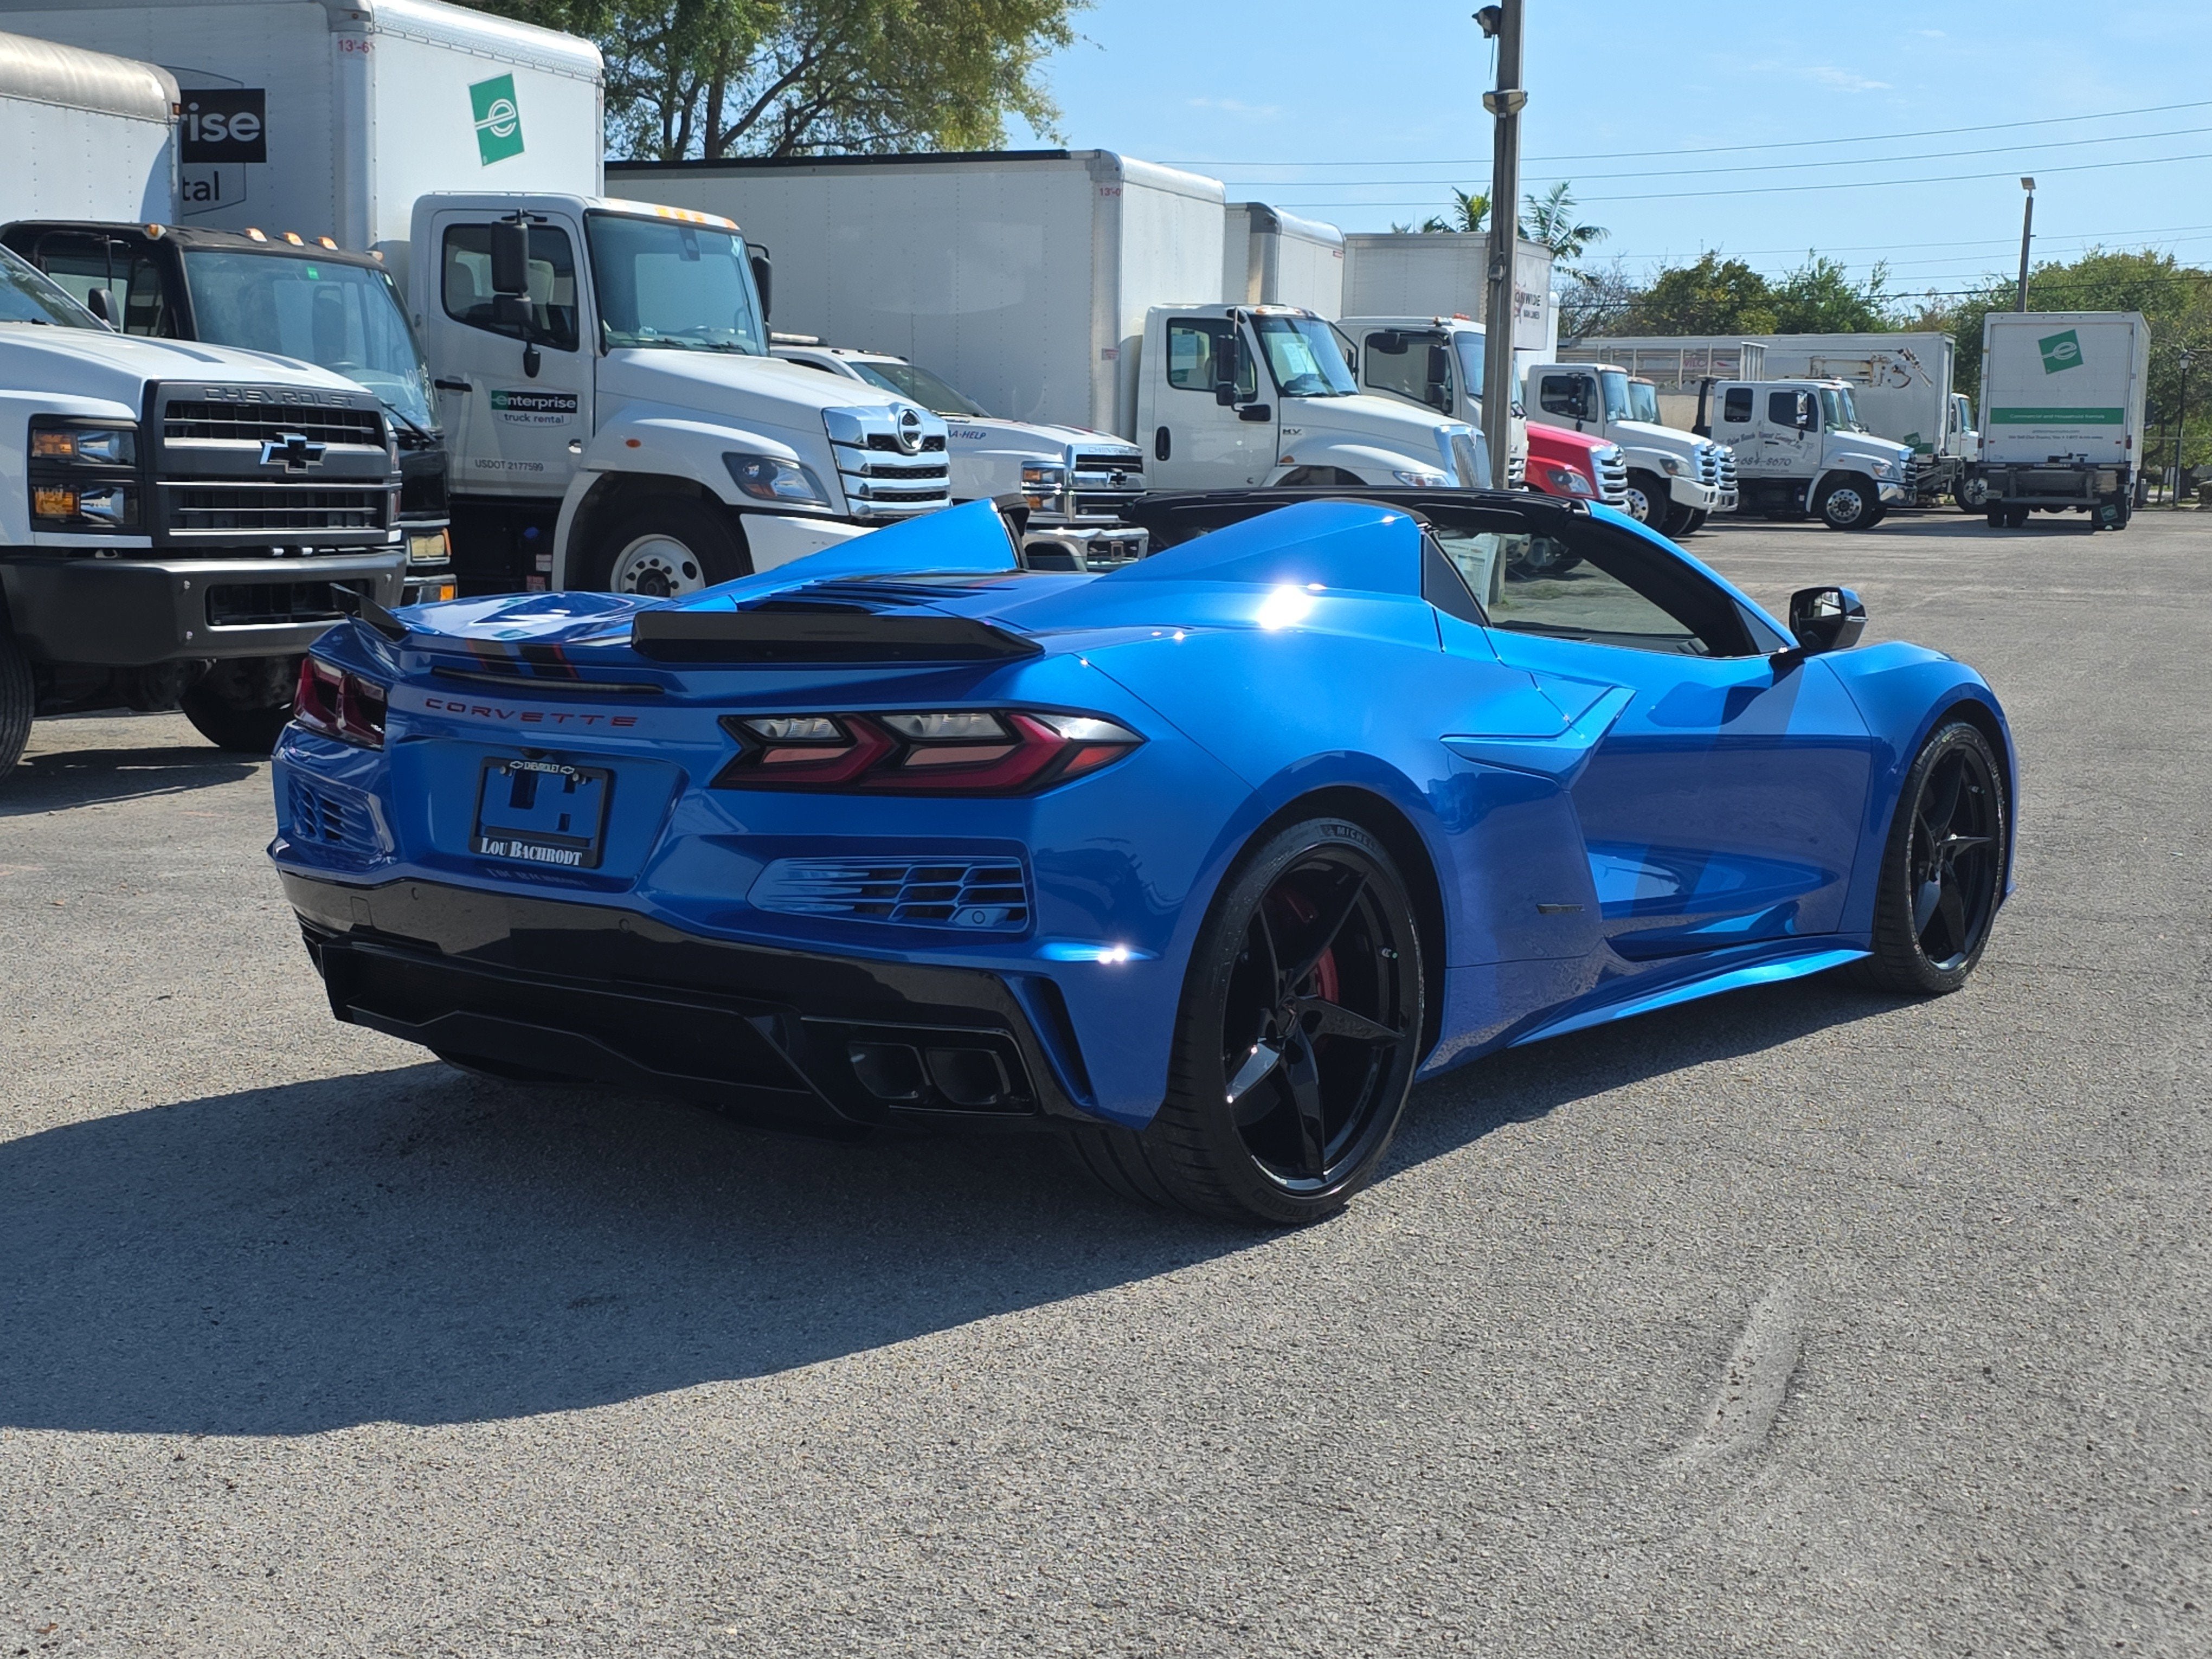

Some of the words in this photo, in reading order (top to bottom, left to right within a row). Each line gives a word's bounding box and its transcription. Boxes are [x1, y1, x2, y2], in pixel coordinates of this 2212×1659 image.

[203, 387, 355, 407] CHEVROLET
[492, 395, 576, 410] enterprise
[504, 413, 530, 422] truck
[534, 415, 564, 423] rental
[474, 459, 506, 469] USDOT
[425, 697, 639, 728] CORVETTE
